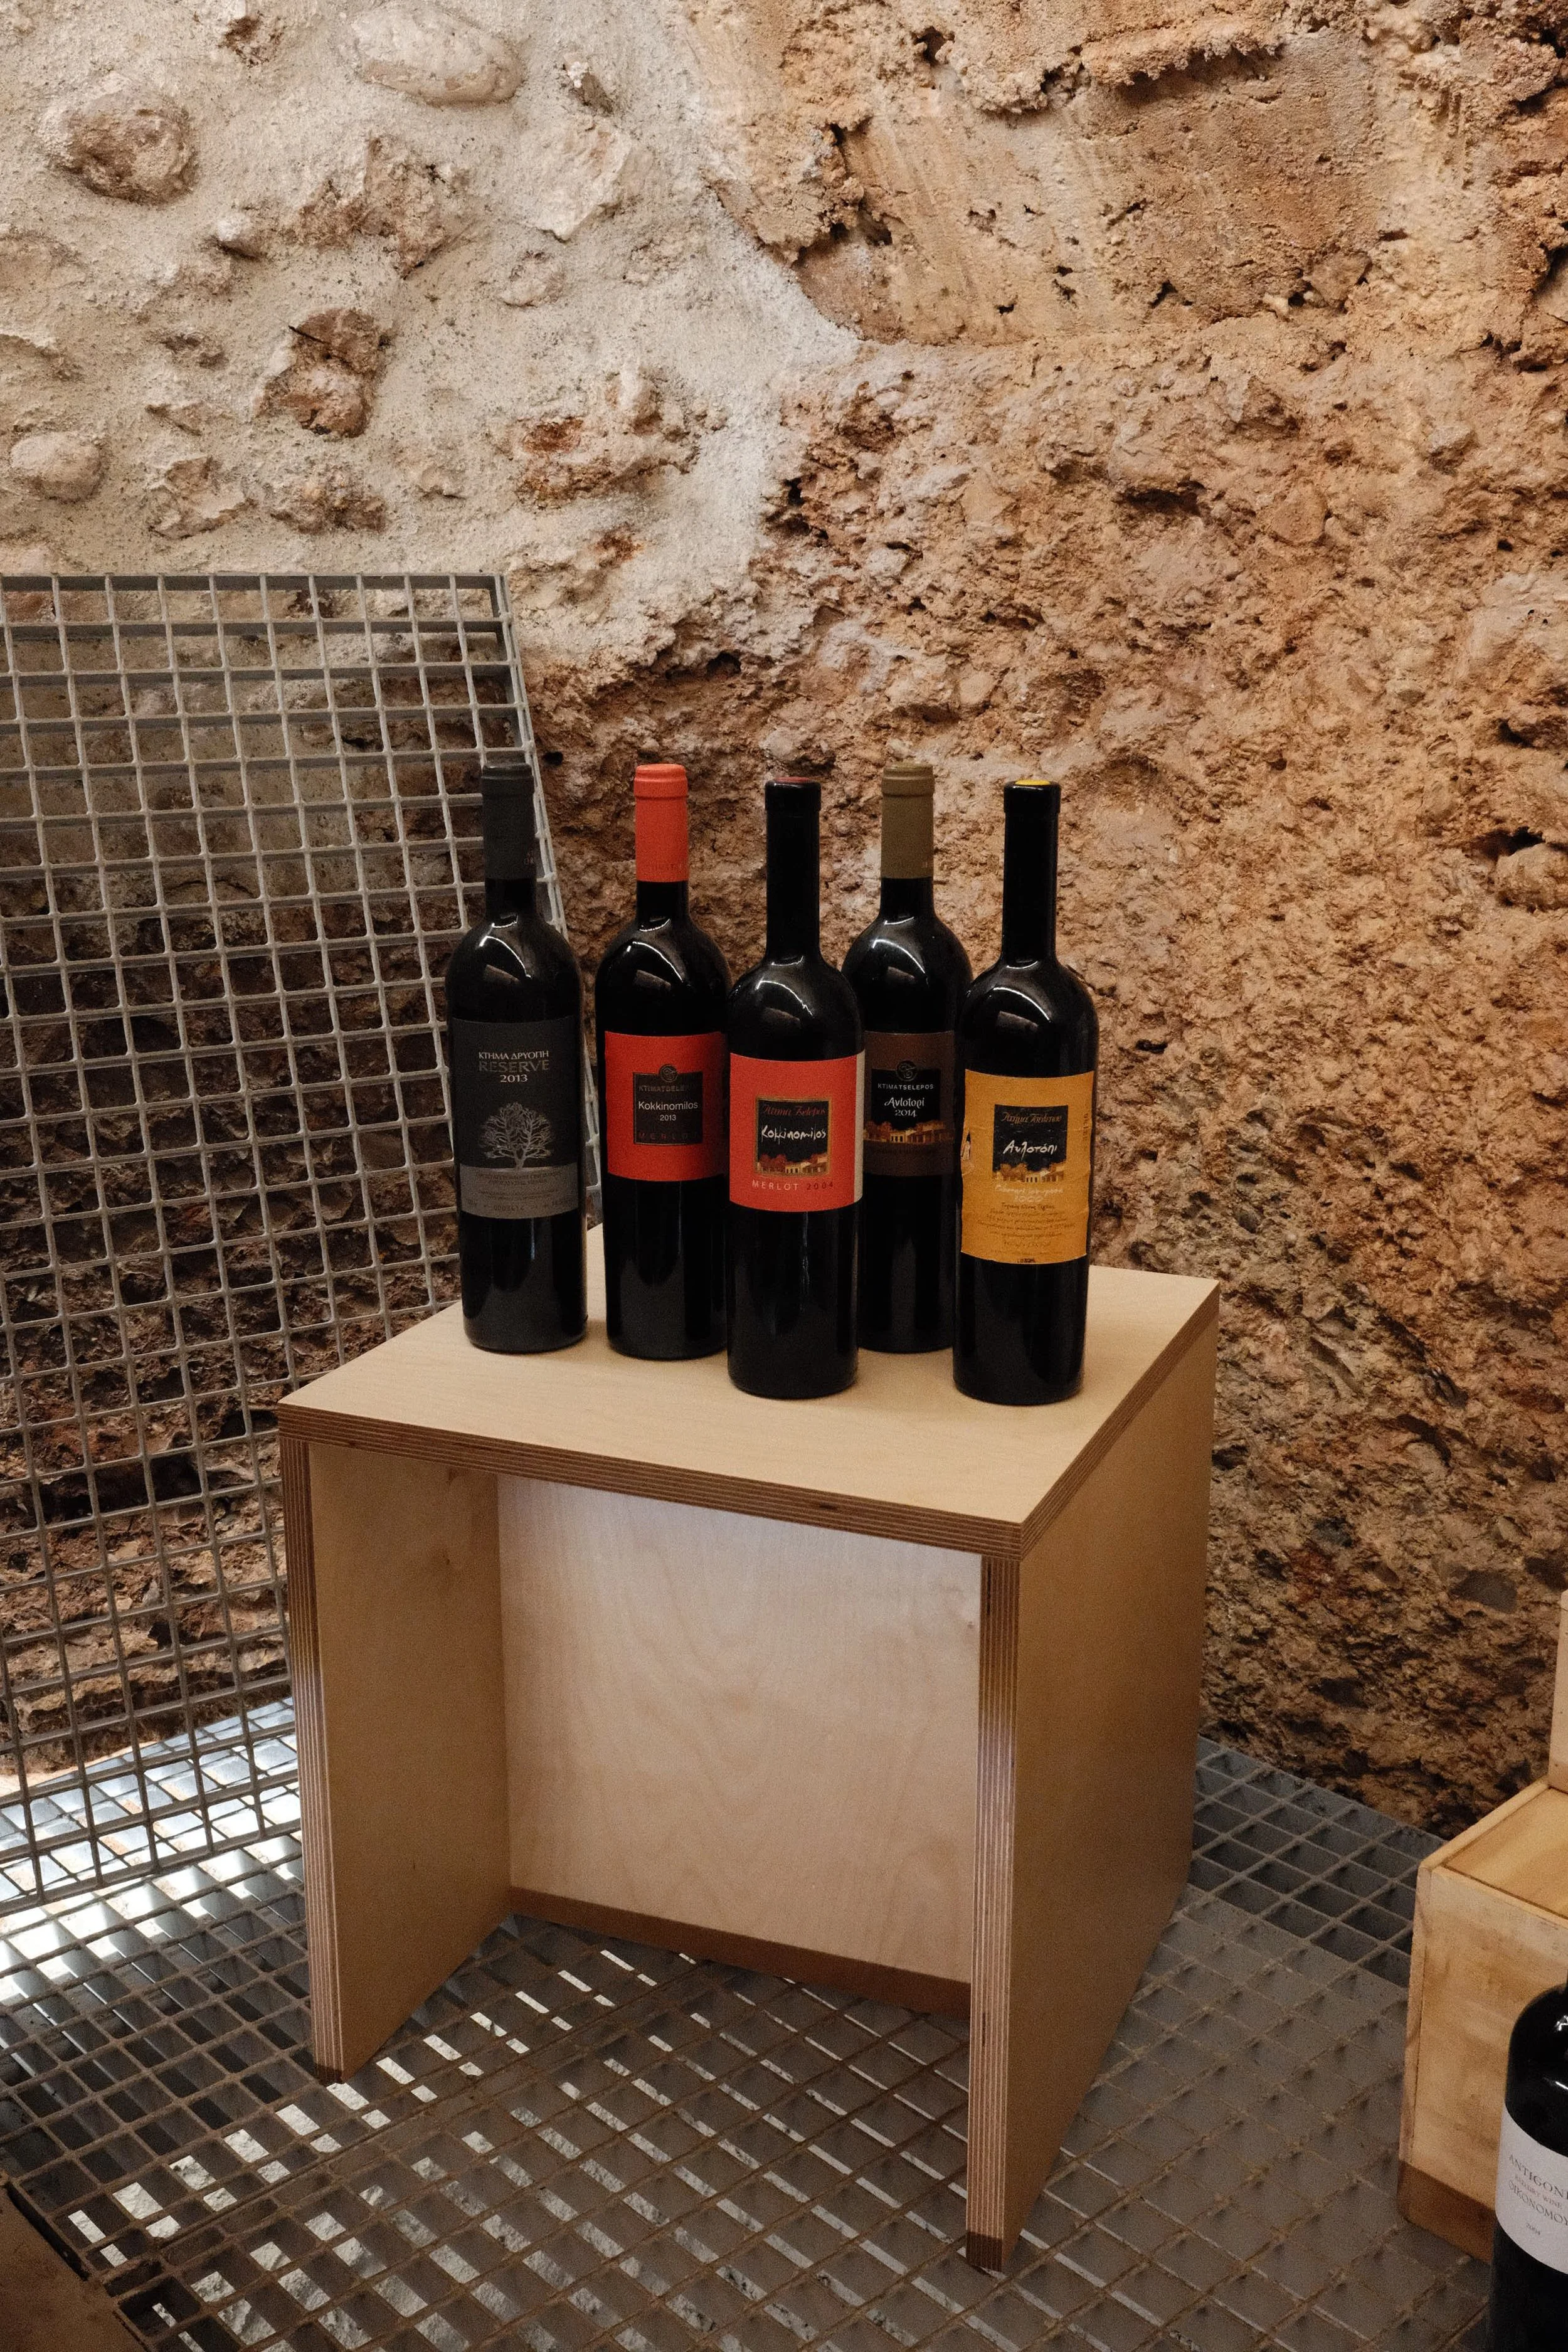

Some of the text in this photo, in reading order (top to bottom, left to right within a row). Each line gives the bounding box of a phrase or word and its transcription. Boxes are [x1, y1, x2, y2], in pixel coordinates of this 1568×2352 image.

[479, 1050, 549, 1060] ΚΤΗΜΑ ΔΡΥΟΠΗ
[479, 1059, 549, 1073] RESERVE
[500, 1074, 528, 1083] 2013
[638, 1101, 699, 1111] Kokkinomilos
[884, 1096, 925, 1109] Avlotopi
[894, 1109, 917, 1118] 2014
[761, 1123, 827, 1145] Kokkinomilos
[752, 1180, 799, 1190] MERLOT
